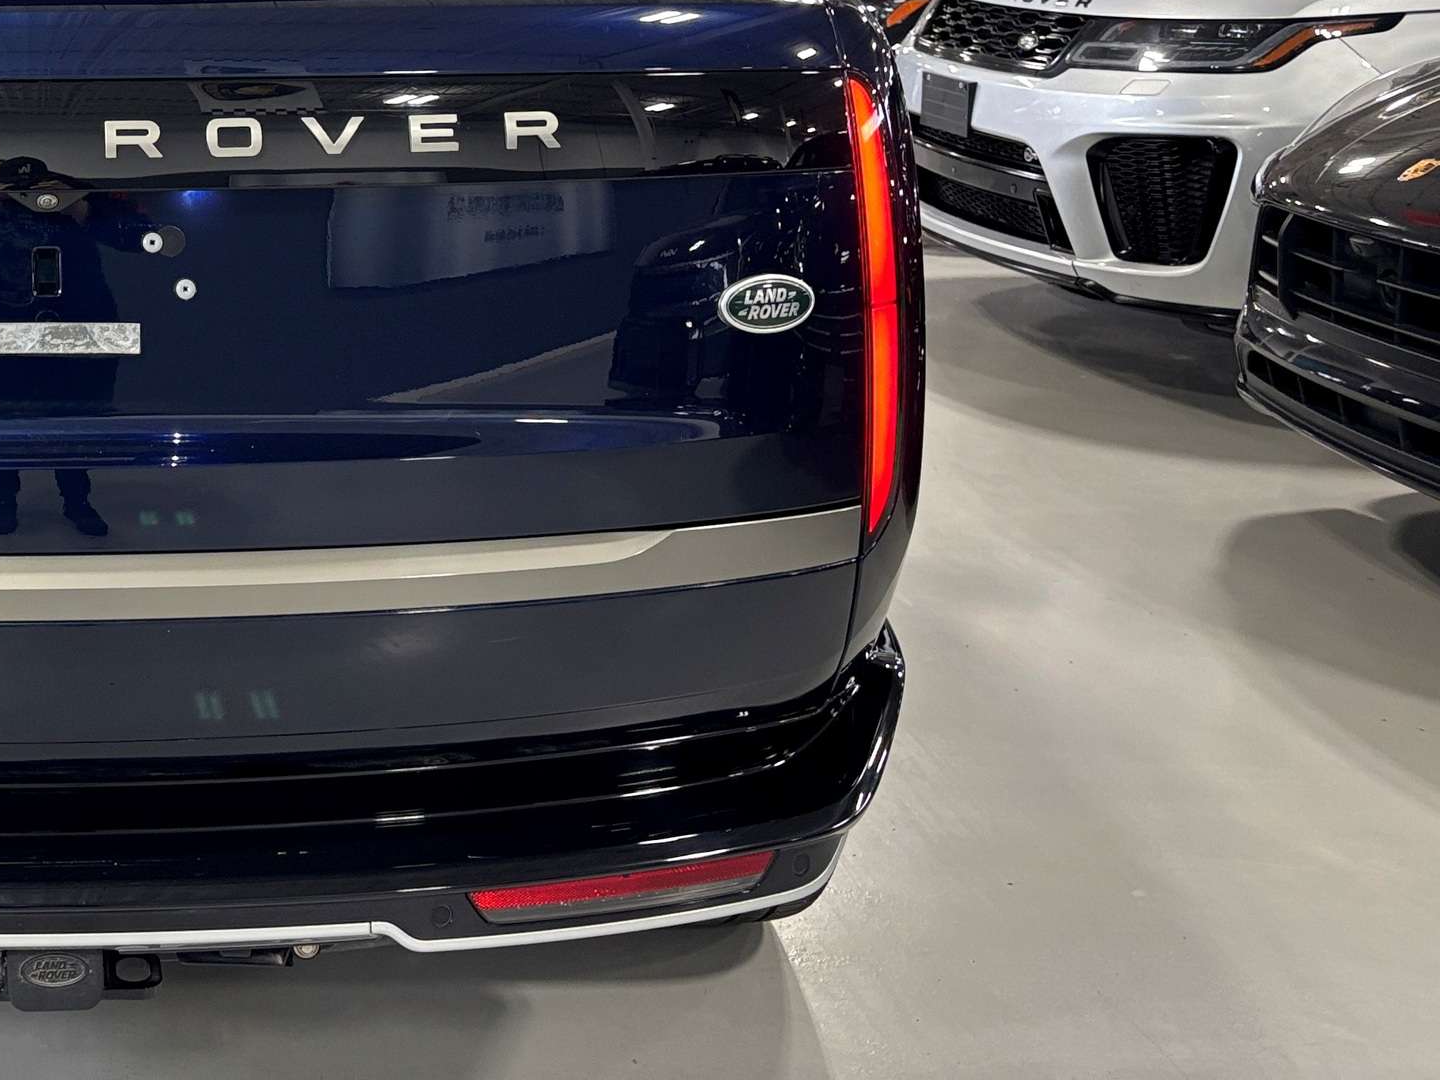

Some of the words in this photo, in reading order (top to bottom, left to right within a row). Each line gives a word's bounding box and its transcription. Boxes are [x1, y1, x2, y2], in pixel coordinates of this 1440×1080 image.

[104, 111, 562, 159] ROVER
[744, 288, 787, 305] LAND
[747, 302, 800, 320] ROVER
